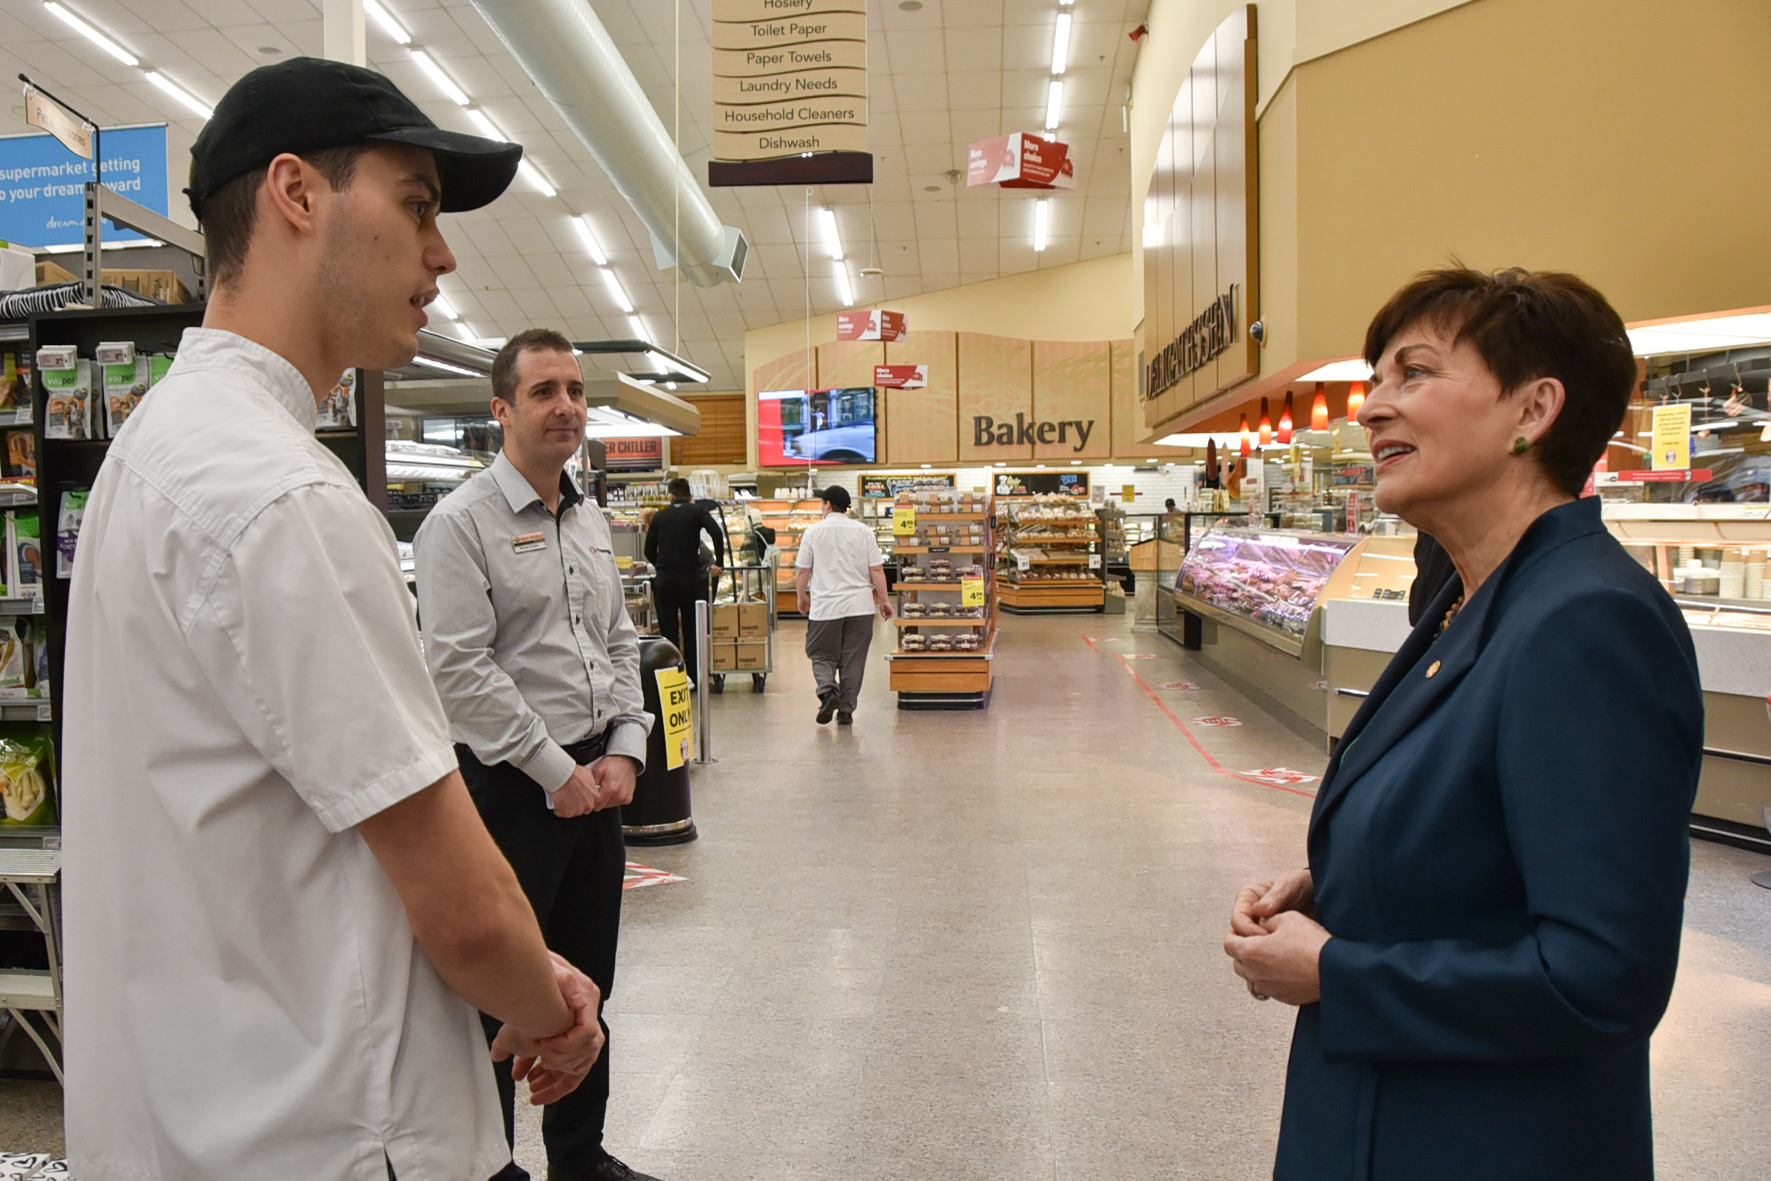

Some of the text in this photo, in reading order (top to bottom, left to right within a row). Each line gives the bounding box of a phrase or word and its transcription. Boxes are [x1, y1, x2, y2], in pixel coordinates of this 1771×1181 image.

[764, 0, 813, 10] Hosiery
[751, 23, 828, 38] Toilet Paper
[747, 50, 832, 67] Paper Towels
[740, 77, 838, 94] Laundry Needs
[725, 107, 855, 122] Household Cleaners
[759, 135, 820, 149] Dishwash
[1024, 139, 1039, 151] More
[0, 157, 141, 182] supermarket getting
[9, 188, 40, 203] your
[43, 184, 85, 198] dream
[99, 176, 141, 192] ward
[1146, 283, 1235, 401] DELICATESSEN
[972, 411, 1096, 453] Bakery
[617, 440, 657, 454] CHILLER
[670, 687, 689, 706] EXIT
[669, 708, 691, 728] ONLY
